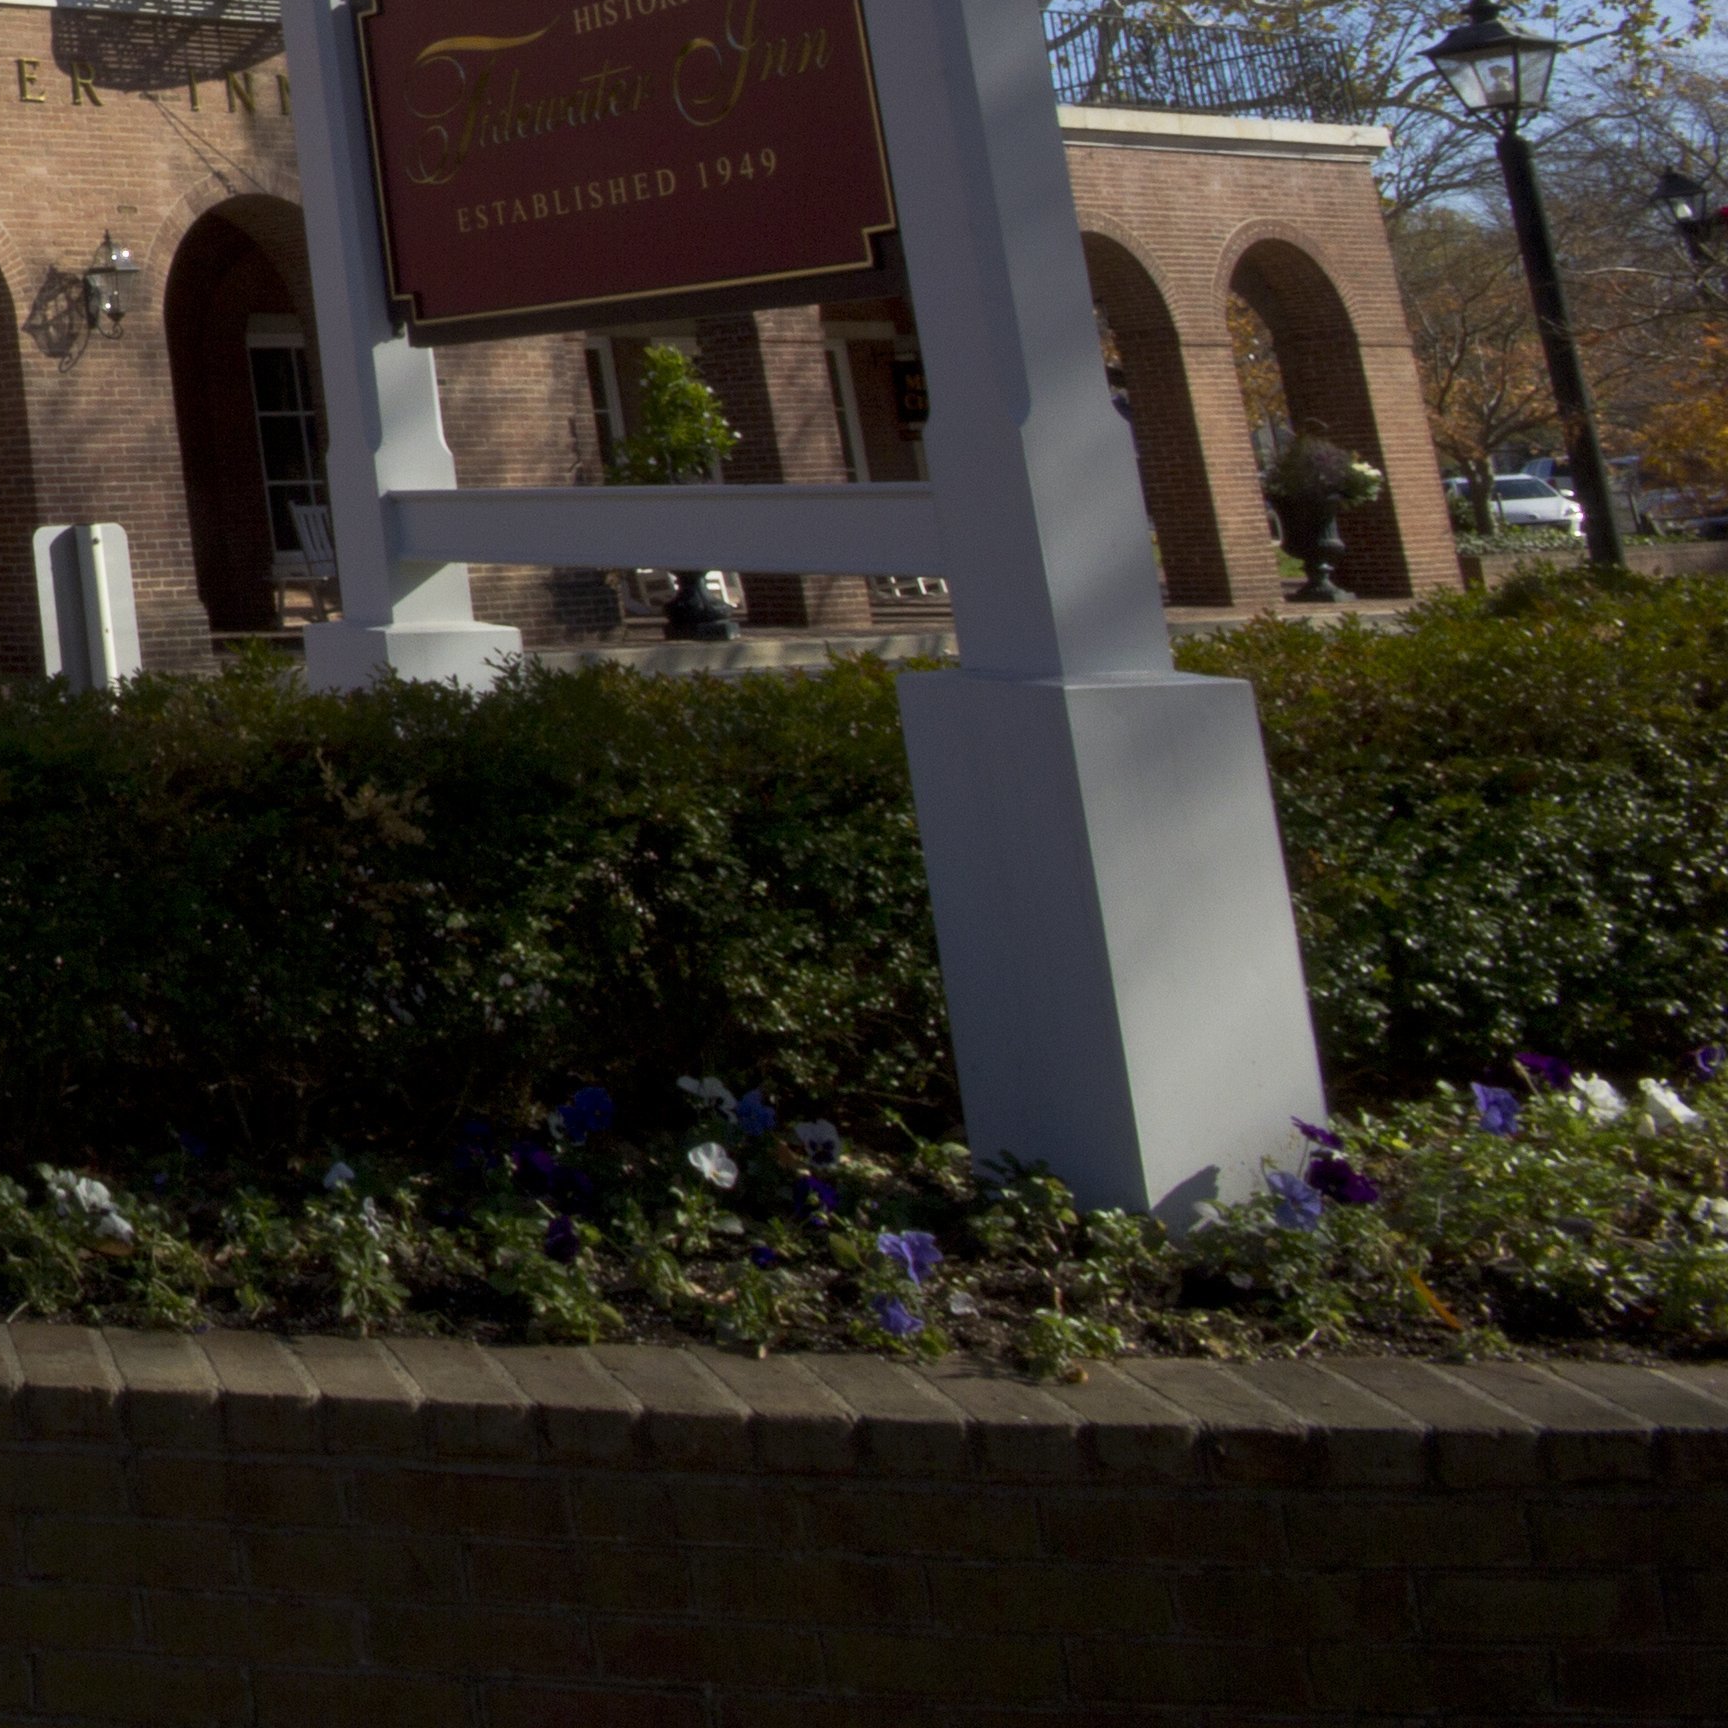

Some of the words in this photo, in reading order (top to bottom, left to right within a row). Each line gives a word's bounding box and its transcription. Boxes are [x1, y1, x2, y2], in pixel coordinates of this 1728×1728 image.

[401, 15, 652, 185] Tidewater
[457, 169, 677, 233] ESTABLISHED
[697, 147, 779, 191] 1949
